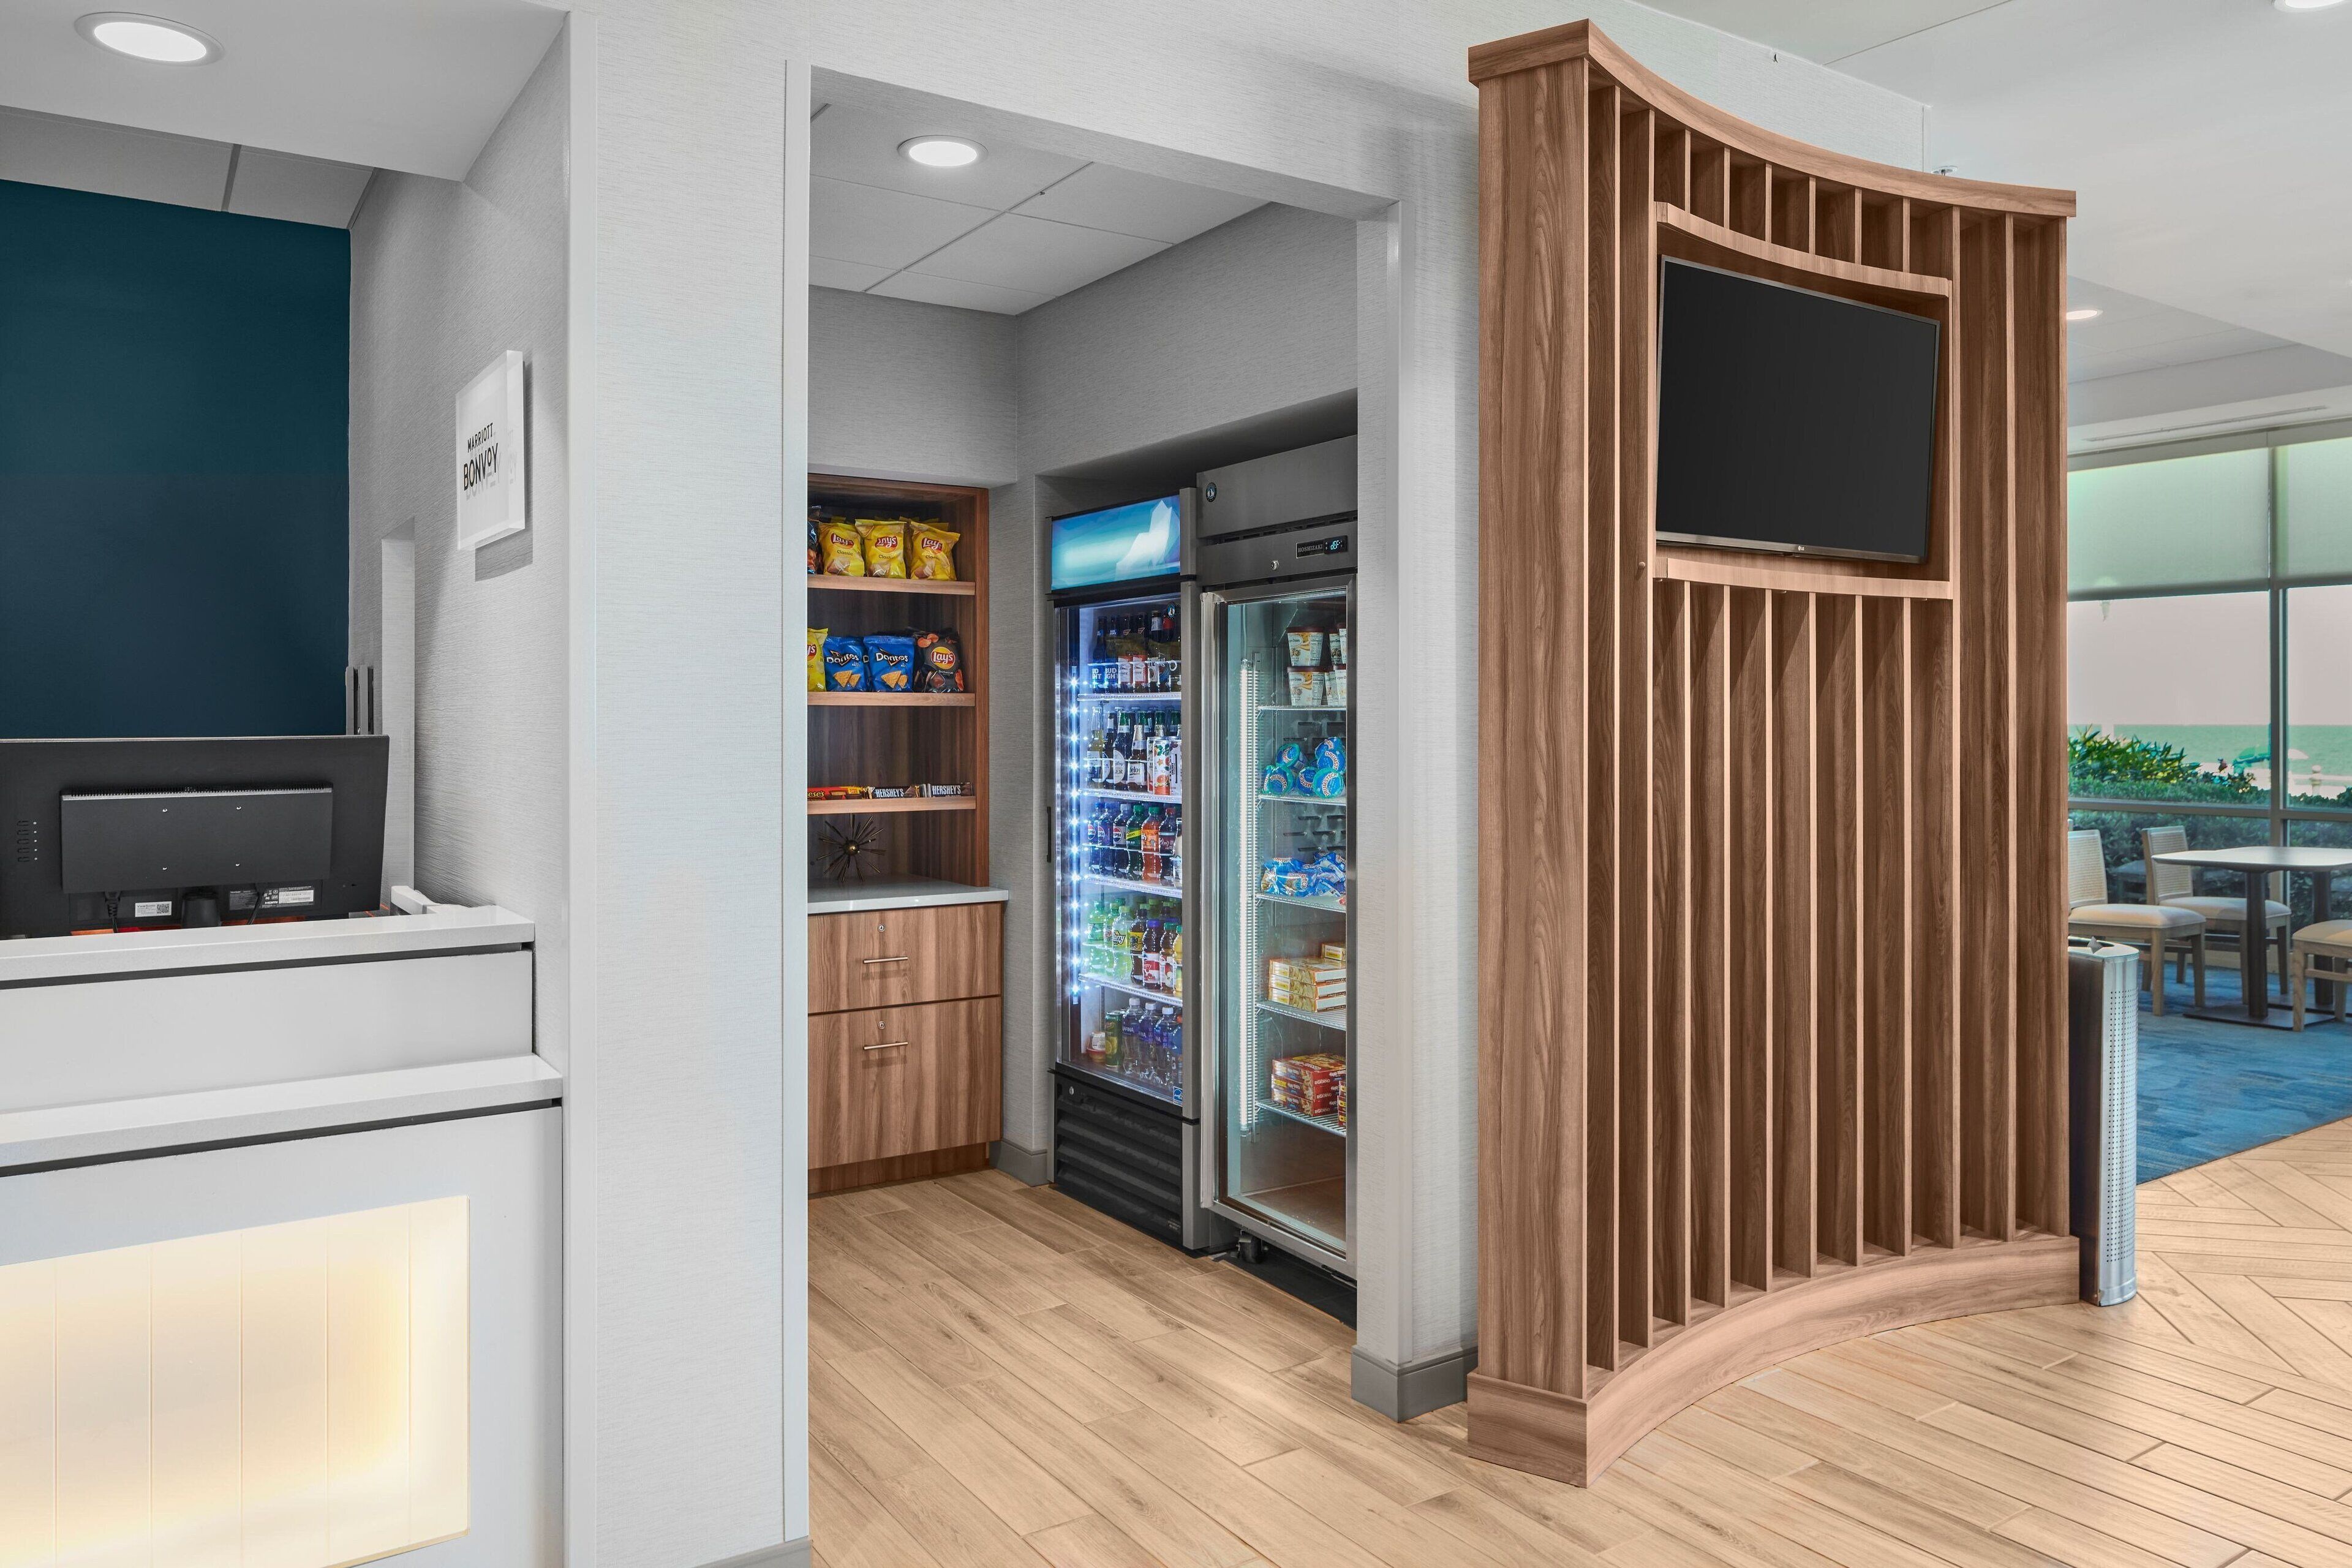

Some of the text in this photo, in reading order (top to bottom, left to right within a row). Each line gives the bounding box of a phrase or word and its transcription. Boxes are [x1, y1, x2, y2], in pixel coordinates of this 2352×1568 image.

[467, 423, 493, 453] MARRIOTT
[464, 443, 498, 491] BONVOY
[1297, 544, 1323, 552] HOSHIZAKI
[826, 653, 859, 663] Doritos
[875, 652, 908, 662] Doritos
[933, 652, 954, 665] Lay's
[876, 788, 904, 797] HERSHEY'S
[932, 785, 961, 795] HERSHEY'S
